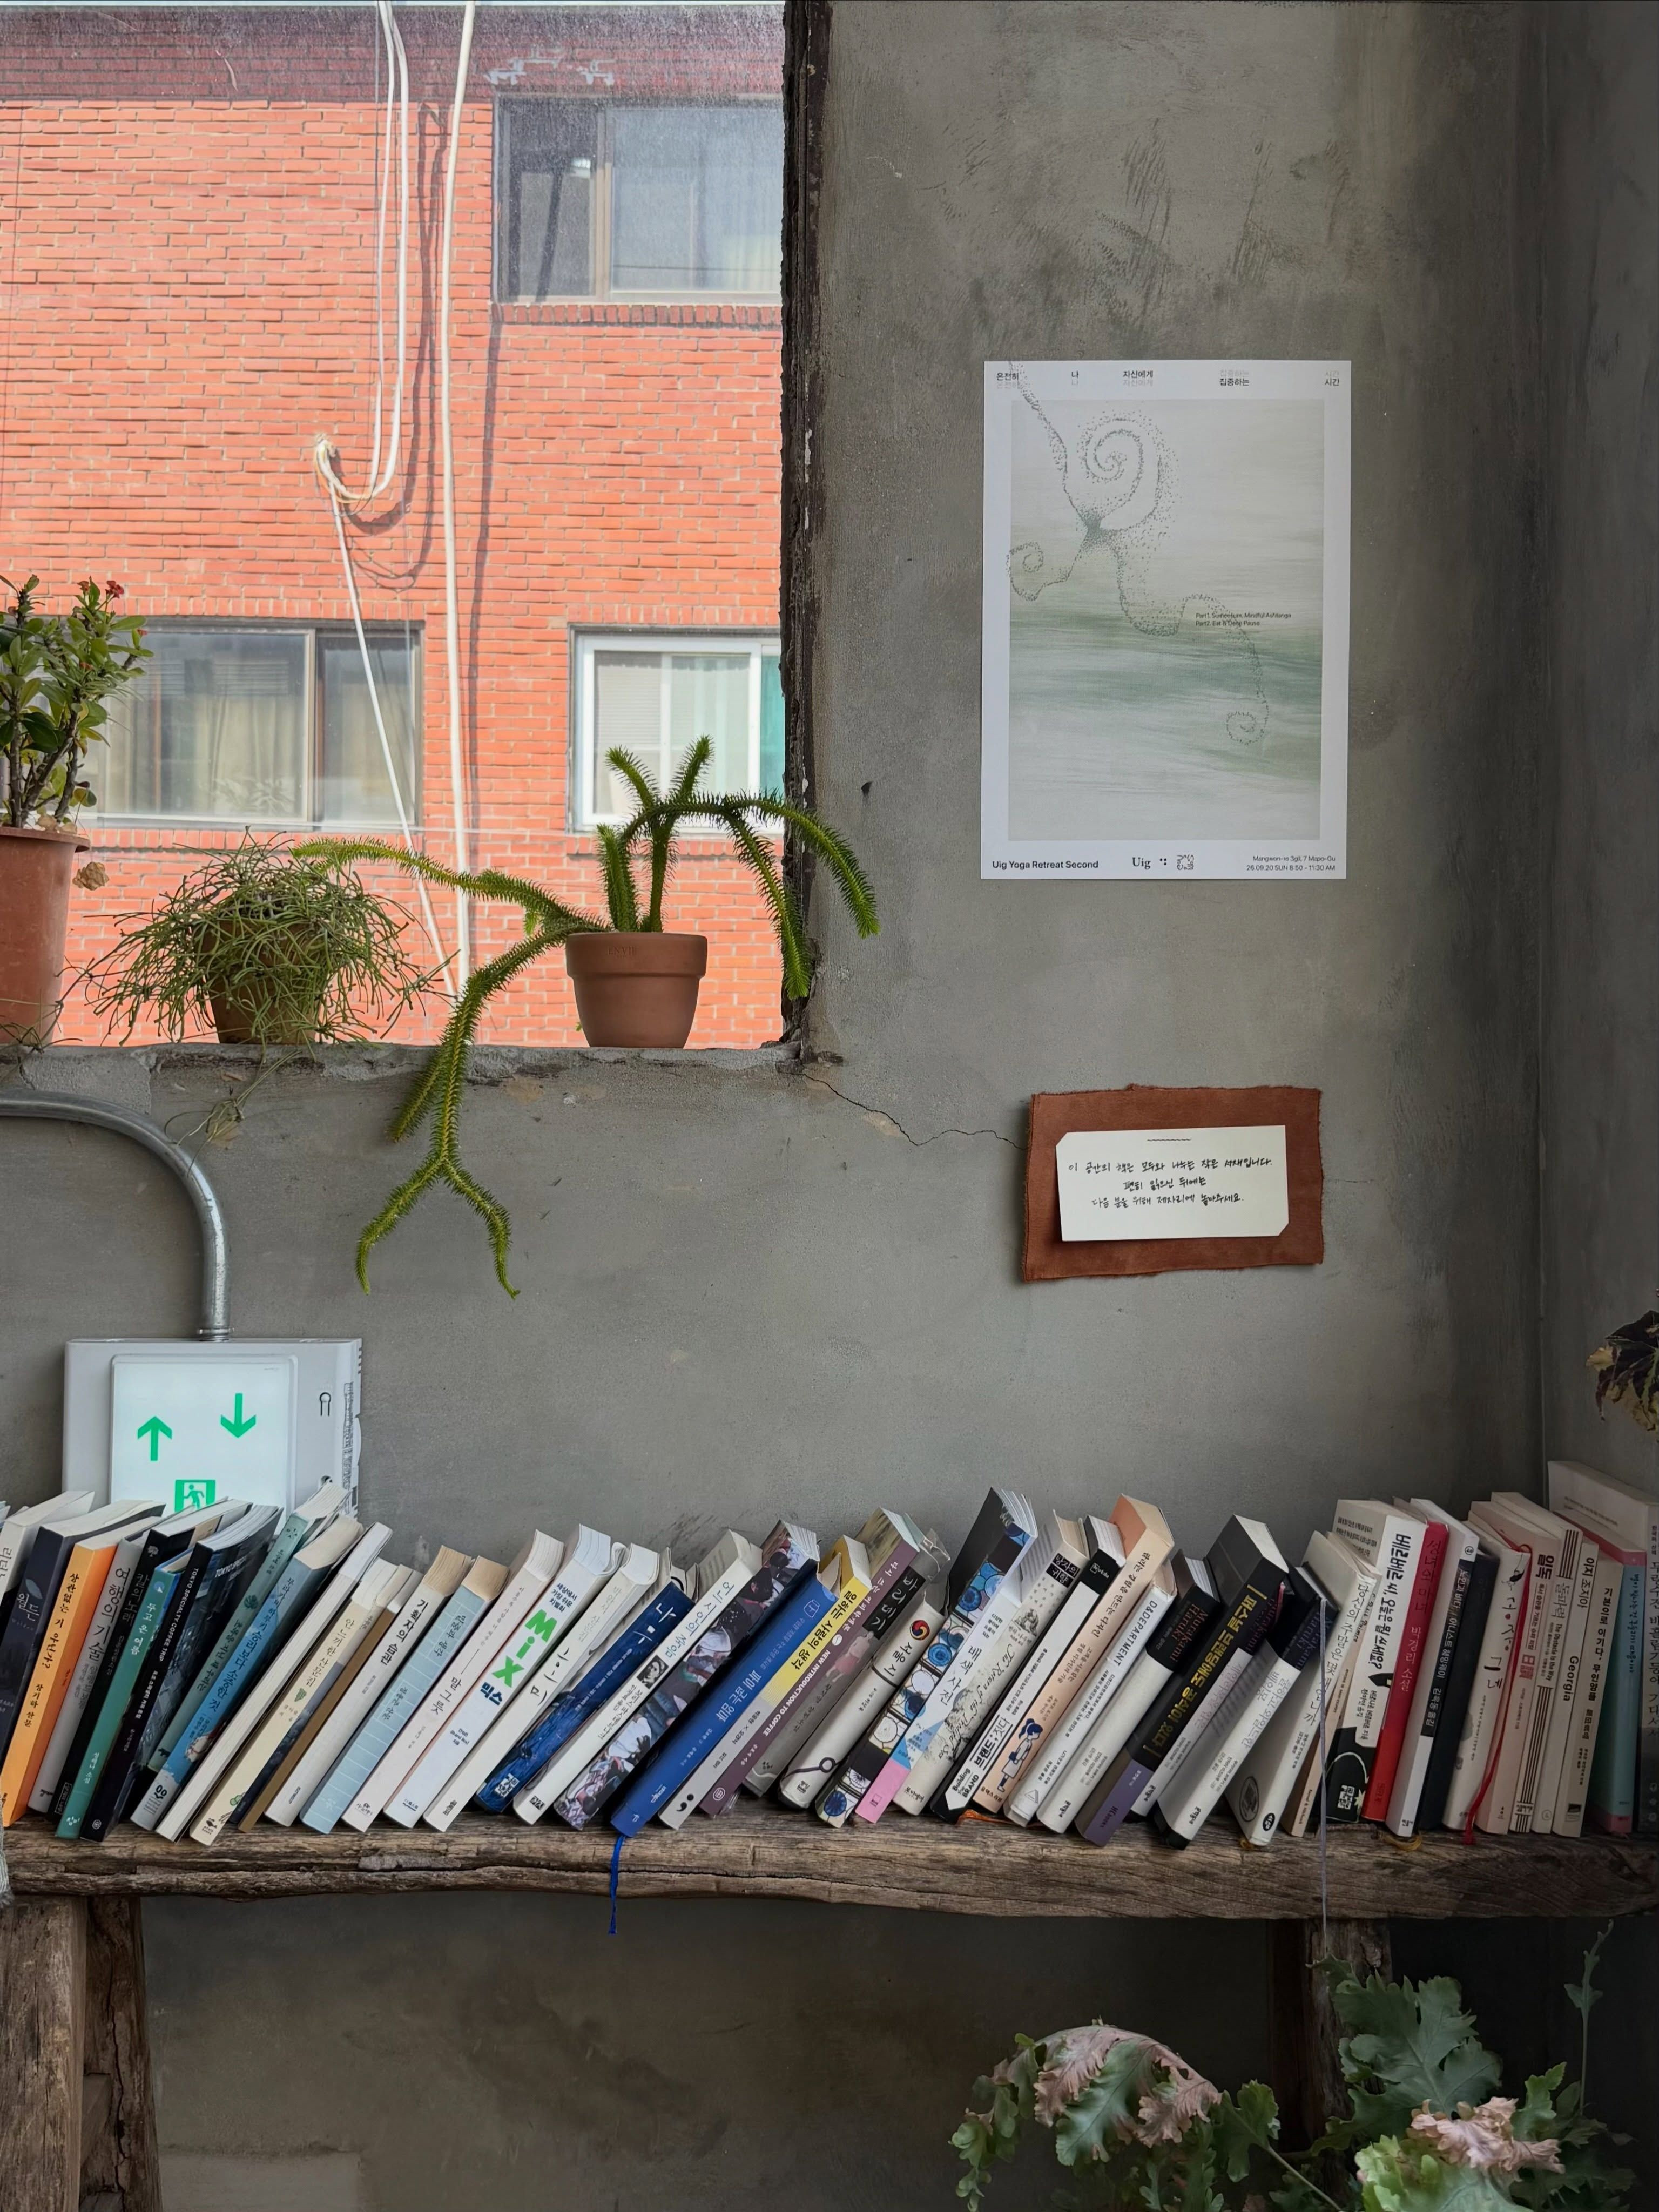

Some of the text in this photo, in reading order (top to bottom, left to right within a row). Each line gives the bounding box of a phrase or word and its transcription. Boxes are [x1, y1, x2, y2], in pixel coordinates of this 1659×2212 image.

[1219, 378, 1250, 386] 집중하는
[1325, 378, 1339, 386] 시간
[993, 861, 1007, 869] Uig
[1009, 861, 1030, 869] Yoga
[1132, 857, 1151, 869] Uig
[1069, 1163, 1077, 1171] 이
[1085, 1162, 1110, 1174] 공간의
[1116, 1162, 1134, 1173] 책은
[1142, 1162, 1165, 1172] 모두와
[1172, 1159, 1195, 1170] 나누는
[1202, 1159, 1218, 1169] 작은
[1092, 1197, 1109, 1208] 다음
[1114, 1196, 1129, 1209] 분을
[1132, 1194, 1151, 1206] 위해
[1157, 1193, 1195, 1204] 제자리에
[1123, 1180, 1143, 1192] 편히
[1179, 1177, 1206, 1188] 뒤에는
[1385, 1532, 1412, 1582] 베르베르
[1535, 1553, 1555, 1580] 일독
[58, 1572, 79, 1615] 상관없는
[841, 1560, 900, 1633] 다시 쓰는 커피학개론
[1091, 1550, 1151, 1637] 팔리는 경험을 만드는 디자인
[1454, 1569, 1468, 1594] 노인과
[1576, 1557, 1595, 1608] 이지 조지아
[17, 1593, 40, 1622] 월든
[84, 1564, 130, 1664] 여행의 기술
[142, 1601, 157, 1622] 두고
[157, 1566, 199, 1662] TOKYO SPECIALTY COFFEE TRIP
[258, 1576, 295, 1631] 무라카미 하루키
[828, 1588, 859, 1622] 일하는
[1345, 1582, 1370, 1622] 당신의
[1377, 1596, 1396, 1623] 오늘은
[1535, 1594, 1543, 1610] 습관을
[1551, 1582, 1570, 1618] 돌파력
[379, 1597, 428, 1667] 기획자의 습관
[663, 1580, 734, 1660] 어느 시인의 죽음
[805, 1617, 835, 1651] 사람의
[1111, 1600, 1158, 1667] D&DEPARTMENT
[1169, 1609, 1209, 1663] Murakami
[1170, 1603, 1201, 1642] Haruki
[1532, 1611, 1540, 1627] 기르는
[129, 1636, 144, 1656] 여름
[232, 1628, 264, 1671] 승리보다
[322, 1626, 348, 1657] 느끼한
[432, 1638, 449, 1658] 생각
[818, 1648, 831, 1664] NEW
[890, 1638, 914, 1665] 서울
[1328, 1621, 1354, 1661] 주말은
[1367, 1635, 1387, 1669] 쓰세요?
[1435, 1616, 1458, 1678] 어니스트 헤밍웨이
[1550, 1633, 1560, 1655] Obstacle
[1588, 1587, 1613, 1701] 기본으로 무인양품
[302, 1654, 329, 1688] 산문집
[789, 1646, 812, 1671] 생각
[935, 1643, 982, 1706] 배색 사전
[1063, 1652, 1080, 1674] 디자인의
[1150, 1593, 1258, 1748] 퍼스널 브랜딩에도 공식이 있다
[1398, 1625, 1422, 1692] 박경리 소설
[195, 1667, 216, 1693] 우리는
[214, 1667, 241, 1702] 소중한
[477, 1681, 506, 1707] 믹스
[786, 1661, 821, 1705] INTRODUCTION
[1561, 1654, 1579, 1702] Georgia
[22, 1683, 43, 1729] 장기하 산문
[381, 1704, 395, 1721] 산문
[714, 1669, 763, 1723] 파이 굽는 엄마
[936, 1643, 1019, 1761] The Return of the Prodigal Son
[1240, 1675, 1292, 1750] 쿨하고 와일드한
[762, 1712, 783, 1737] COFFEE
[1424, 1710, 1437, 1727] 옮김
[952, 1766, 971, 1792] Building
[962, 1773, 979, 1798] BRAND
[66, 1816, 80, 1826] 창비
